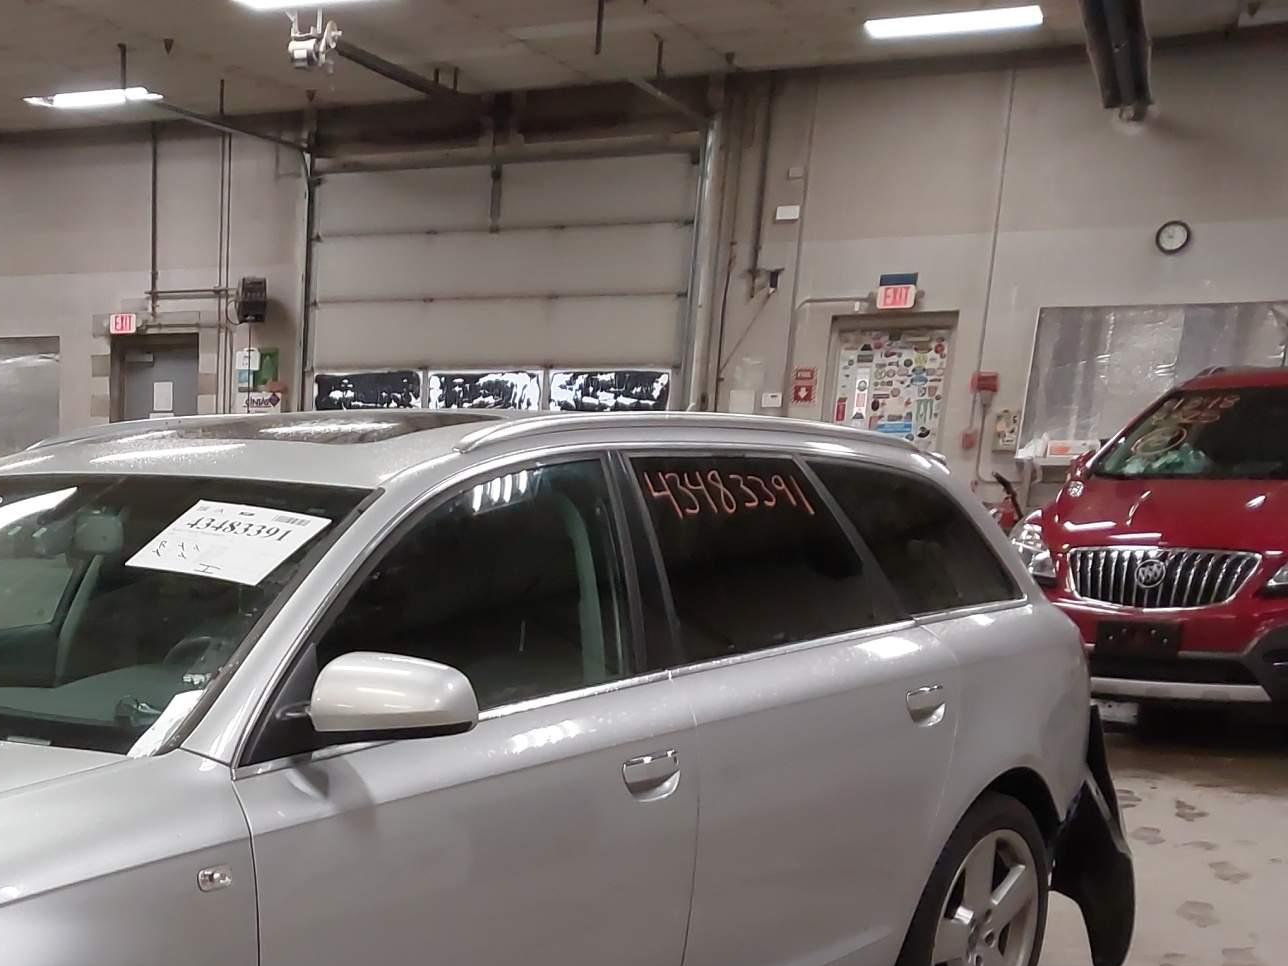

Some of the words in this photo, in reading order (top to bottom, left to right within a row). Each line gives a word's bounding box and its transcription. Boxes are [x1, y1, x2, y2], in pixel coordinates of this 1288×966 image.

[883, 286, 910, 307] EXIT
[643, 469, 815, 520] 43483391
[186, 516, 292, 541] 43483391
